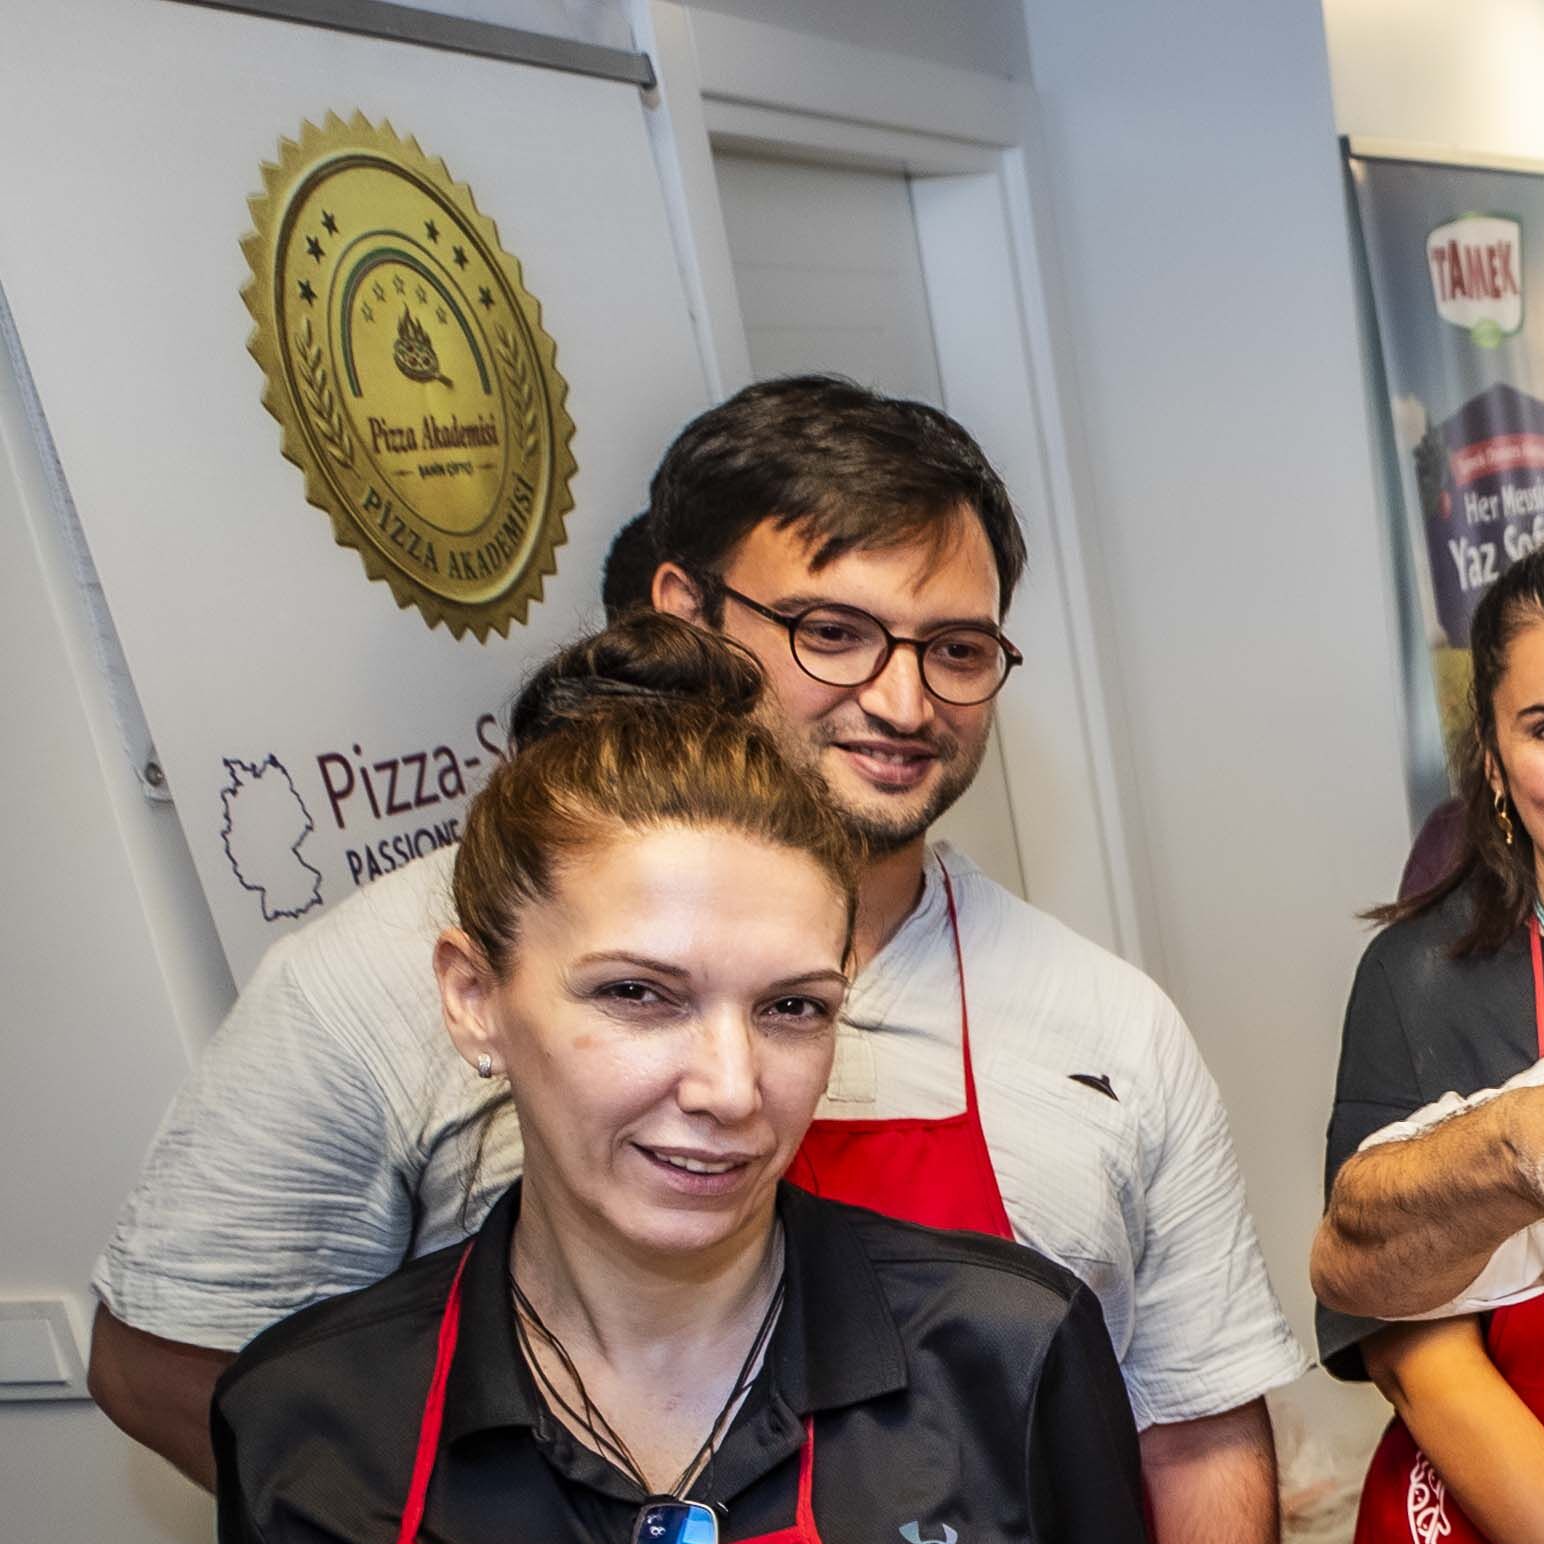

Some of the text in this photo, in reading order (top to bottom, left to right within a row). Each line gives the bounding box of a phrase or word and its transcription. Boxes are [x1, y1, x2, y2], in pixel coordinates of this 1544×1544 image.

[368, 412, 499, 453] Pizza Akademisi
[1464, 492, 1499, 526] Her
[1449, 536, 1500, 592] Yaz
